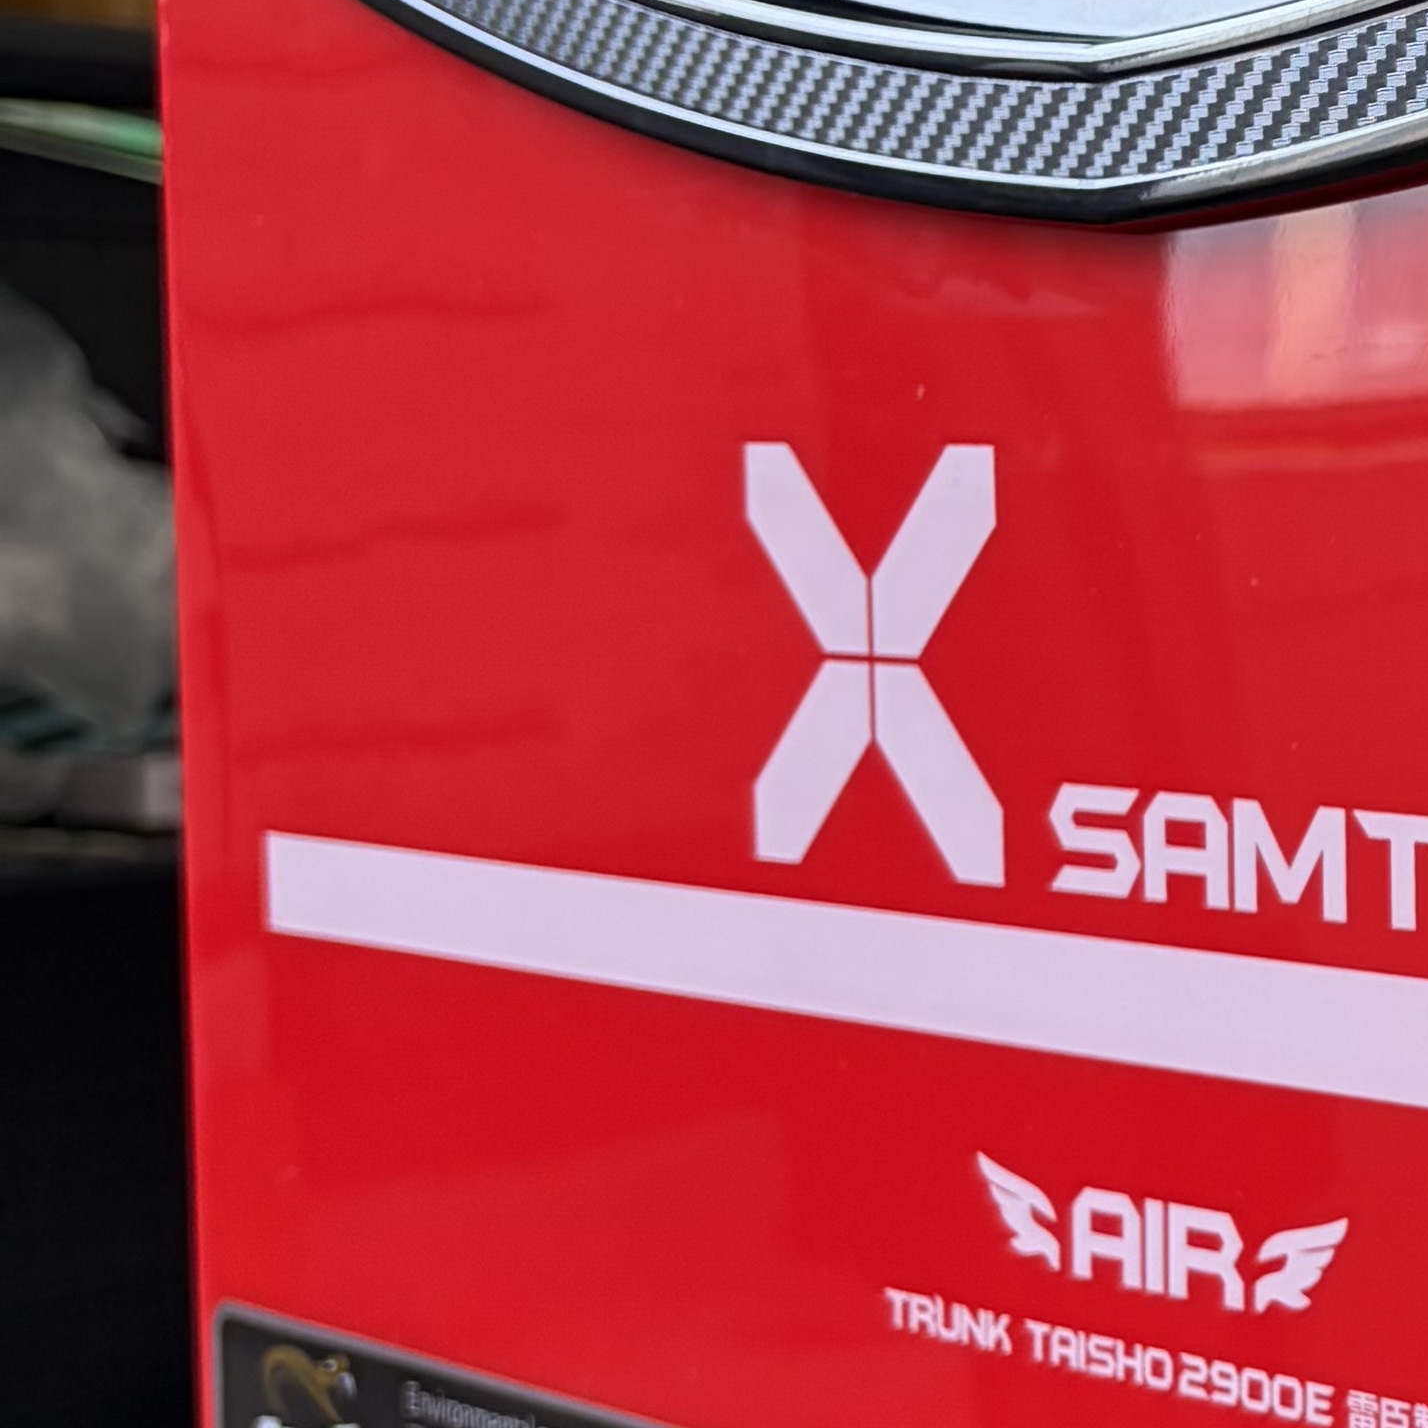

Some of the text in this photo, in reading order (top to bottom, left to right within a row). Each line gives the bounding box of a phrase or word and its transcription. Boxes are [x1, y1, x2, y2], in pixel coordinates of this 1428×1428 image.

[1071, 1185, 1245, 1312] AIR
[883, 1285, 1013, 1355] TRUNK
[1024, 1317, 1173, 1394] TAISHO
[1178, 1351, 1336, 1428] 2900E
